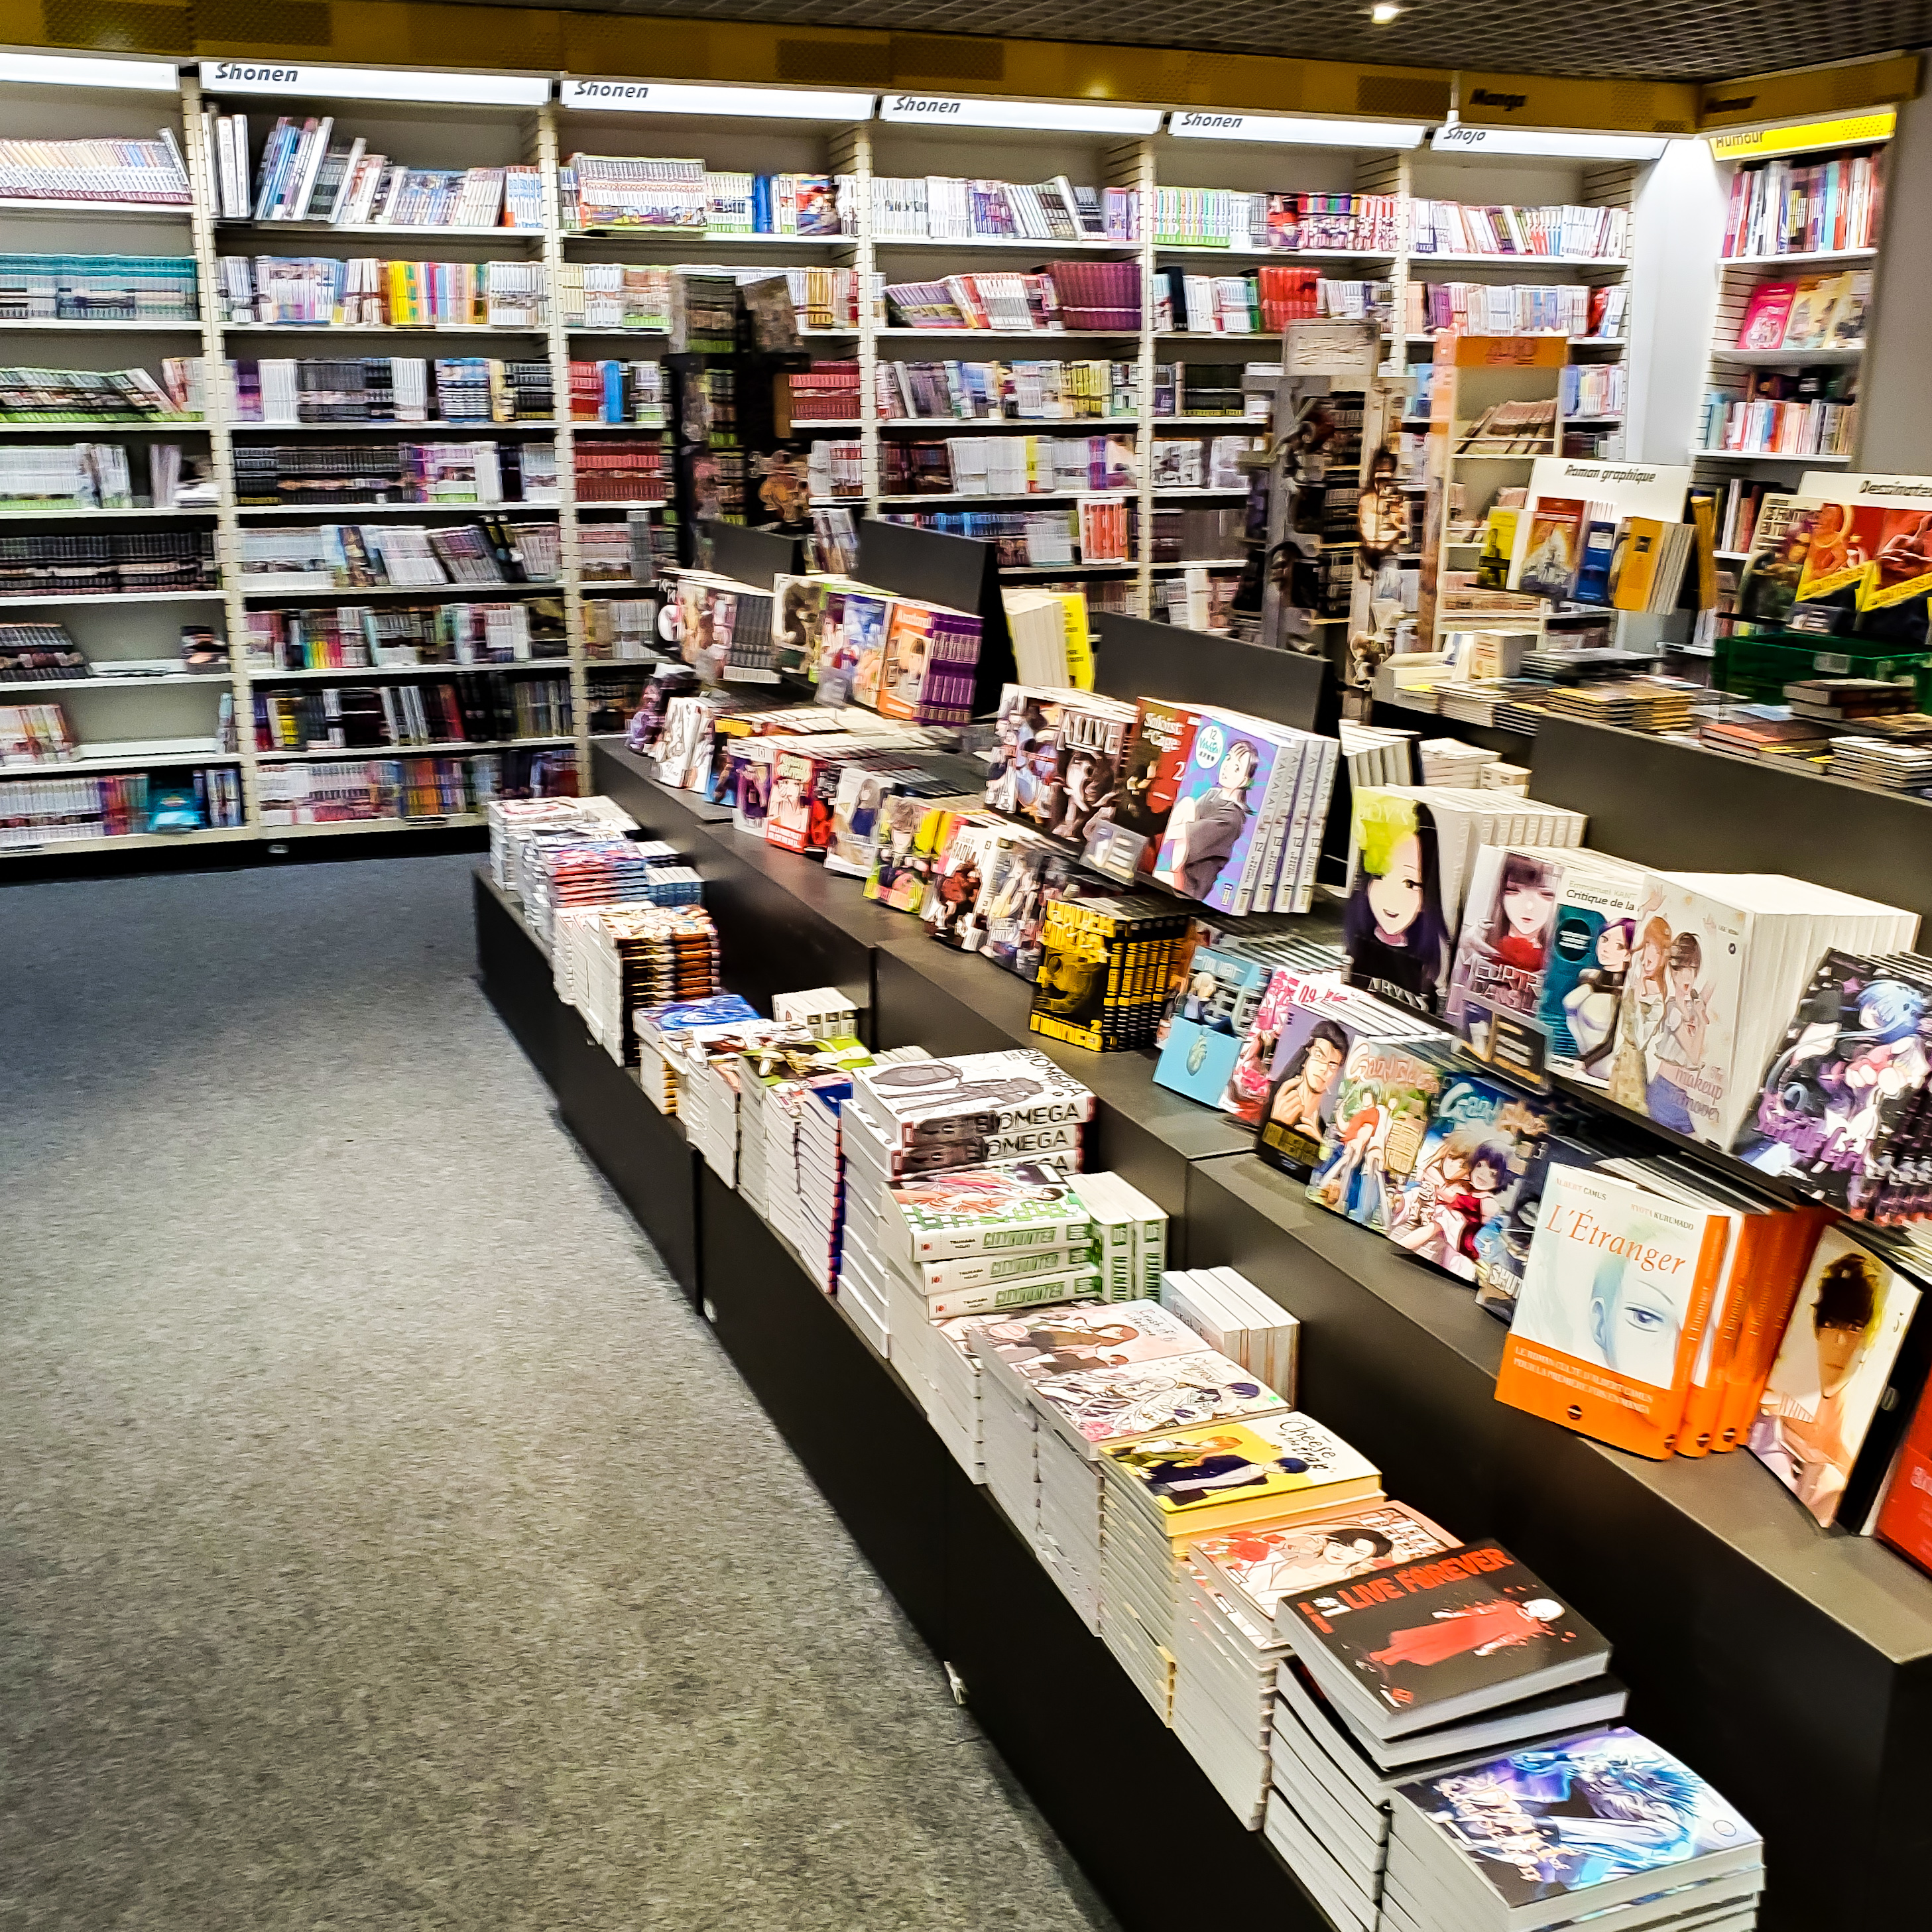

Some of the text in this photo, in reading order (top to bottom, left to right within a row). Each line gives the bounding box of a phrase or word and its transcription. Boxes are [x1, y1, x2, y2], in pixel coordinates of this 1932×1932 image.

[215, 63, 299, 83] Shonen
[574, 81, 649, 99] Shonen
[892, 96, 961, 113] Shonen
[1181, 113, 1243, 129] Shonen
[1443, 127, 1486, 145] Shojo
[1564, 464, 1656, 485] Roman graphique
[1209, 729, 1217, 741] 12
[1172, 760, 1187, 782] 2
[1566, 888, 1635, 911] Critique de la
[1016, 1048, 1091, 1097] BIOMEGA
[1675, 1067, 1723, 1106] makeup
[1555, 1177, 1607, 1201] ALBERT CAMUS
[1545, 1203, 1687, 1274] L'Étranger
[1279, 1421, 1336, 1459] Cheese
[1336, 1577, 1407, 1610] LIVE
[1394, 1547, 1515, 1594] FOREVER
